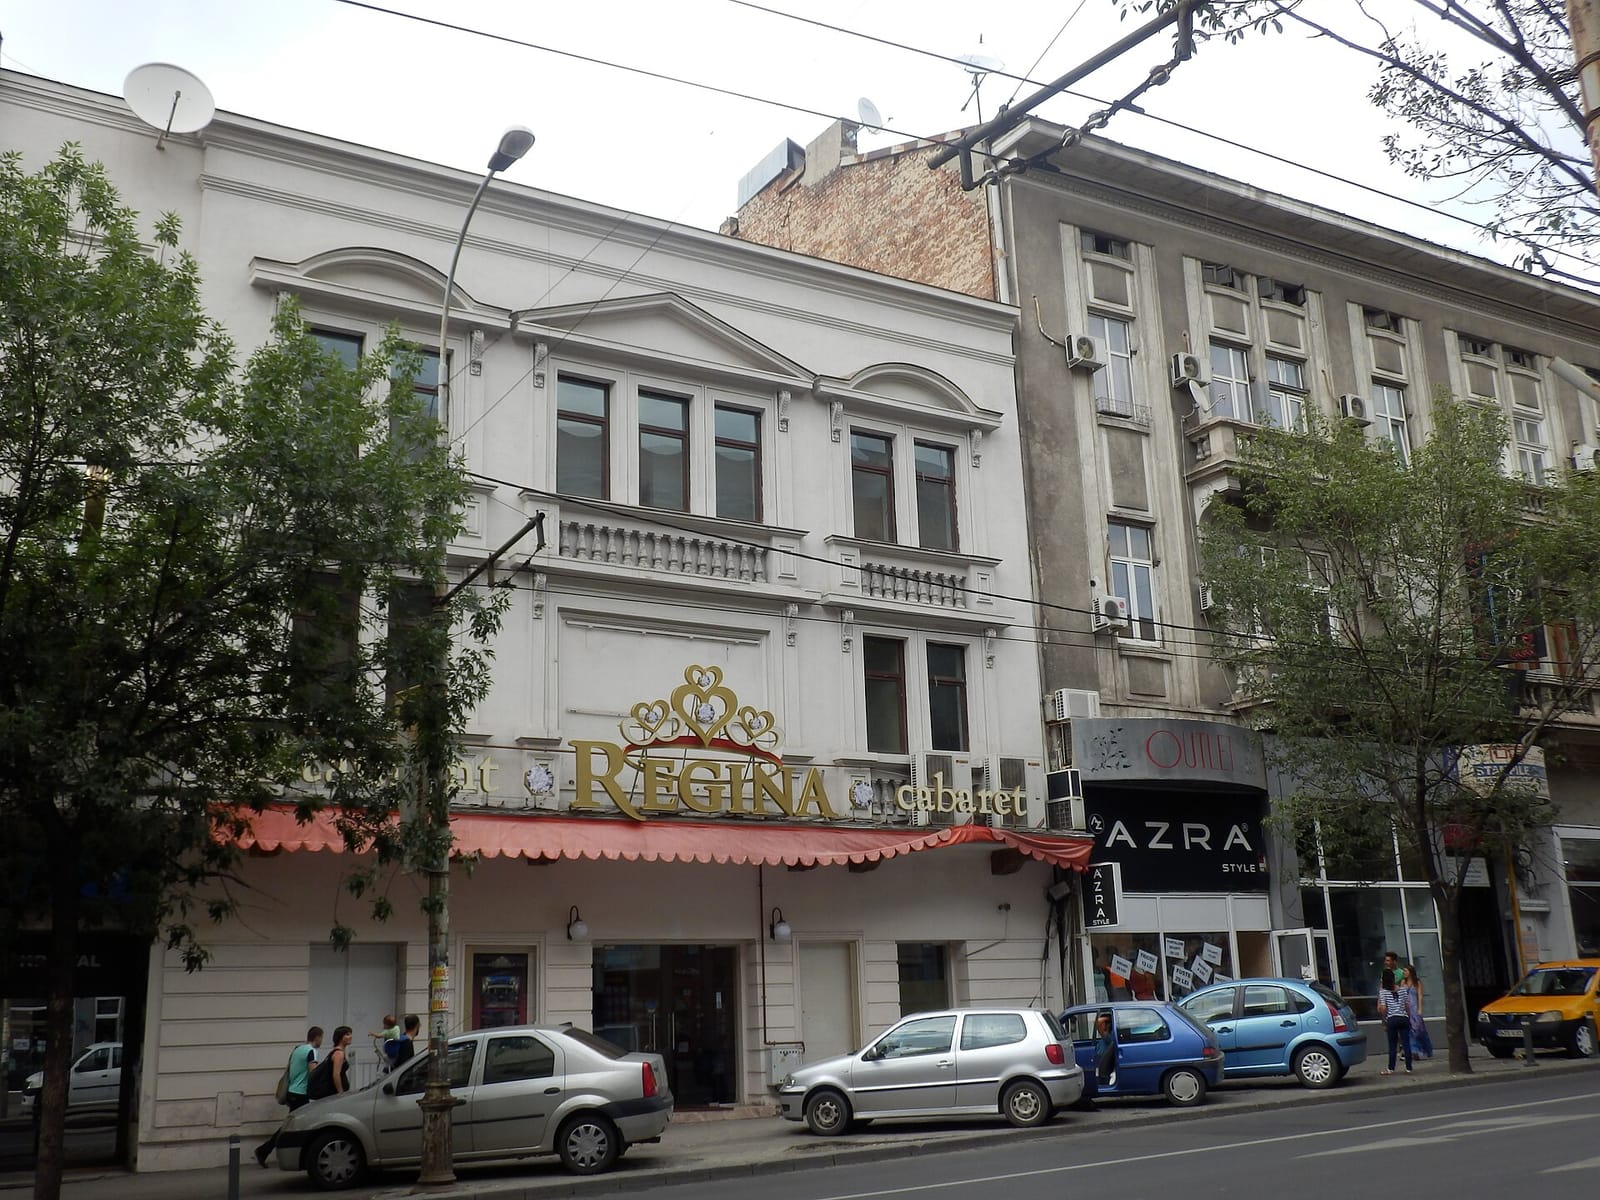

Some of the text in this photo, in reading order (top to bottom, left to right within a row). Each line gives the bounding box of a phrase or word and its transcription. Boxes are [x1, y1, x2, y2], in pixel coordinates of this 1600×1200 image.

[1145, 730, 1234, 771] OUTLET
[567, 739, 839, 822] REGINA
[895, 771, 1027, 817] cabaret
[1105, 820, 1253, 852] AZRA
[1222, 863, 1256, 873] STYLE
[1092, 868, 1106, 918] AZRA
[1092, 918, 1110, 926] STYLE
